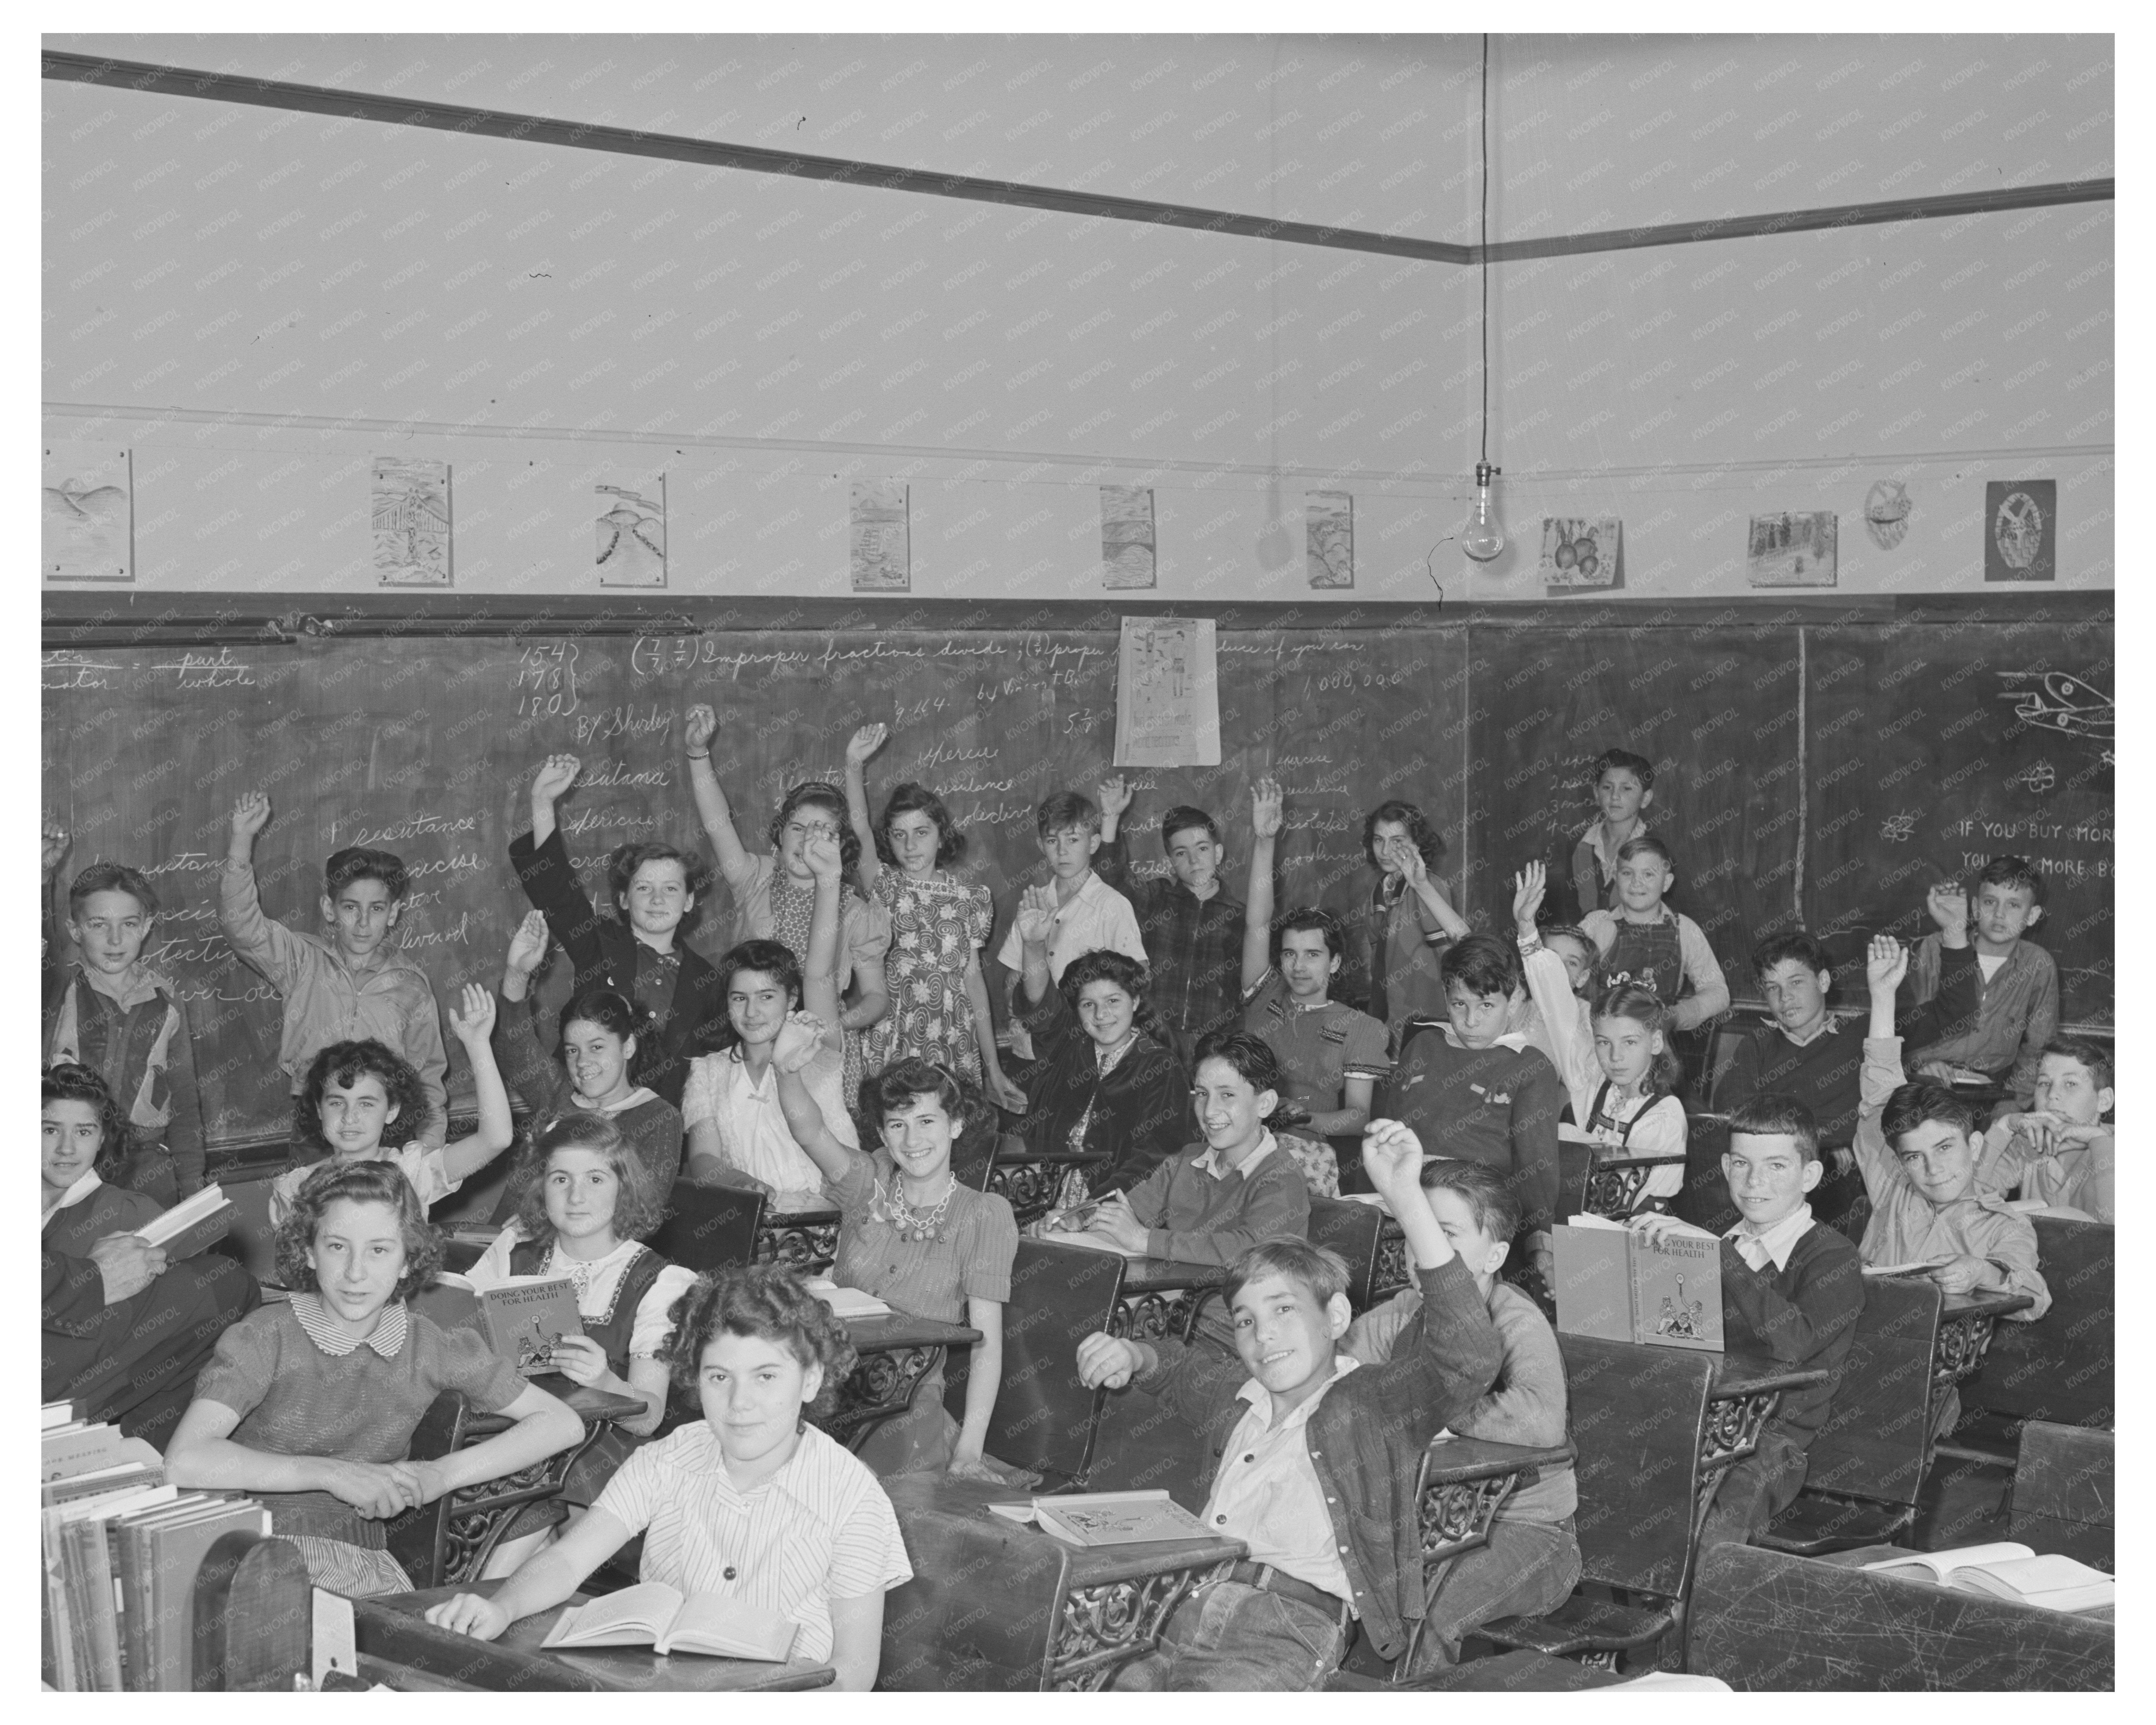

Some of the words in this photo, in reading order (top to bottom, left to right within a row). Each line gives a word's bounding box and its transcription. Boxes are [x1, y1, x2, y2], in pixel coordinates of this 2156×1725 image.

[520, 642, 566, 666] 154
[1216, 640, 1260, 653] duce
[1264, 636, 1285, 660] if
[1290, 642, 1325, 658] you
[177, 647, 234, 678] part
[176, 669, 255, 689] whole
[518, 694, 562, 716] 180
[1960, 820, 1974, 837] IF
[1982, 821, 2016, 839] YOU
[2029, 824, 2062, 839] BUY
[1962, 851, 1990, 868] YOU
[2041, 857, 2085, 876] MORE
[1653, 1246, 1670, 1255] FOR
[1672, 1248, 1704, 1258] HEALTH
[1671, 1239, 1694, 1249] YOUR
[1696, 1241, 1715, 1251] BEST
[490, 1290, 520, 1300] DOING
[521, 1286, 546, 1296] YOUR
[548, 1282, 569, 1291] BEST
[503, 1297, 522, 1306] FOR
[523, 1291, 559, 1304] HEALTH
